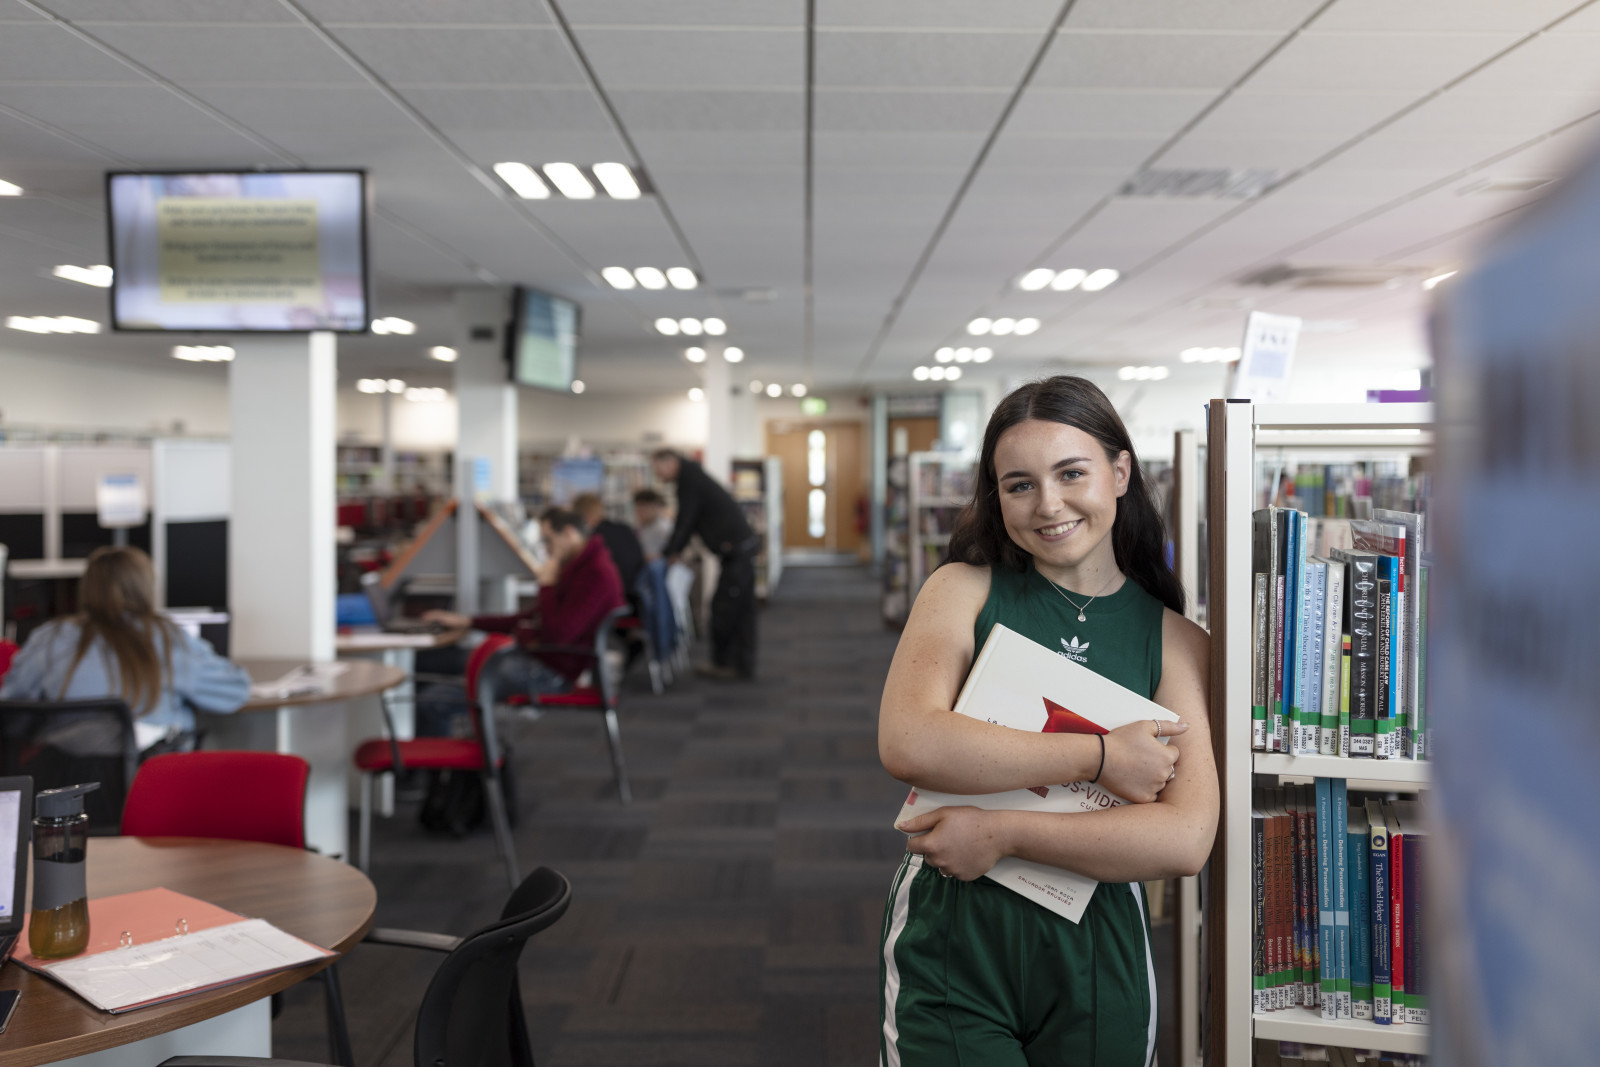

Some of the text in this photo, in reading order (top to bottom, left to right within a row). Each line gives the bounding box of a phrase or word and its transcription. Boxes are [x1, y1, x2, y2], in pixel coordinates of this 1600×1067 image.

[1057, 651, 1088, 663] adidas
[1059, 891, 1074, 901] ROCA
[1376, 877, 1384, 899] Skilled
[1360, 891, 1368, 924] GROUP
[1374, 900, 1384, 921] Helper
